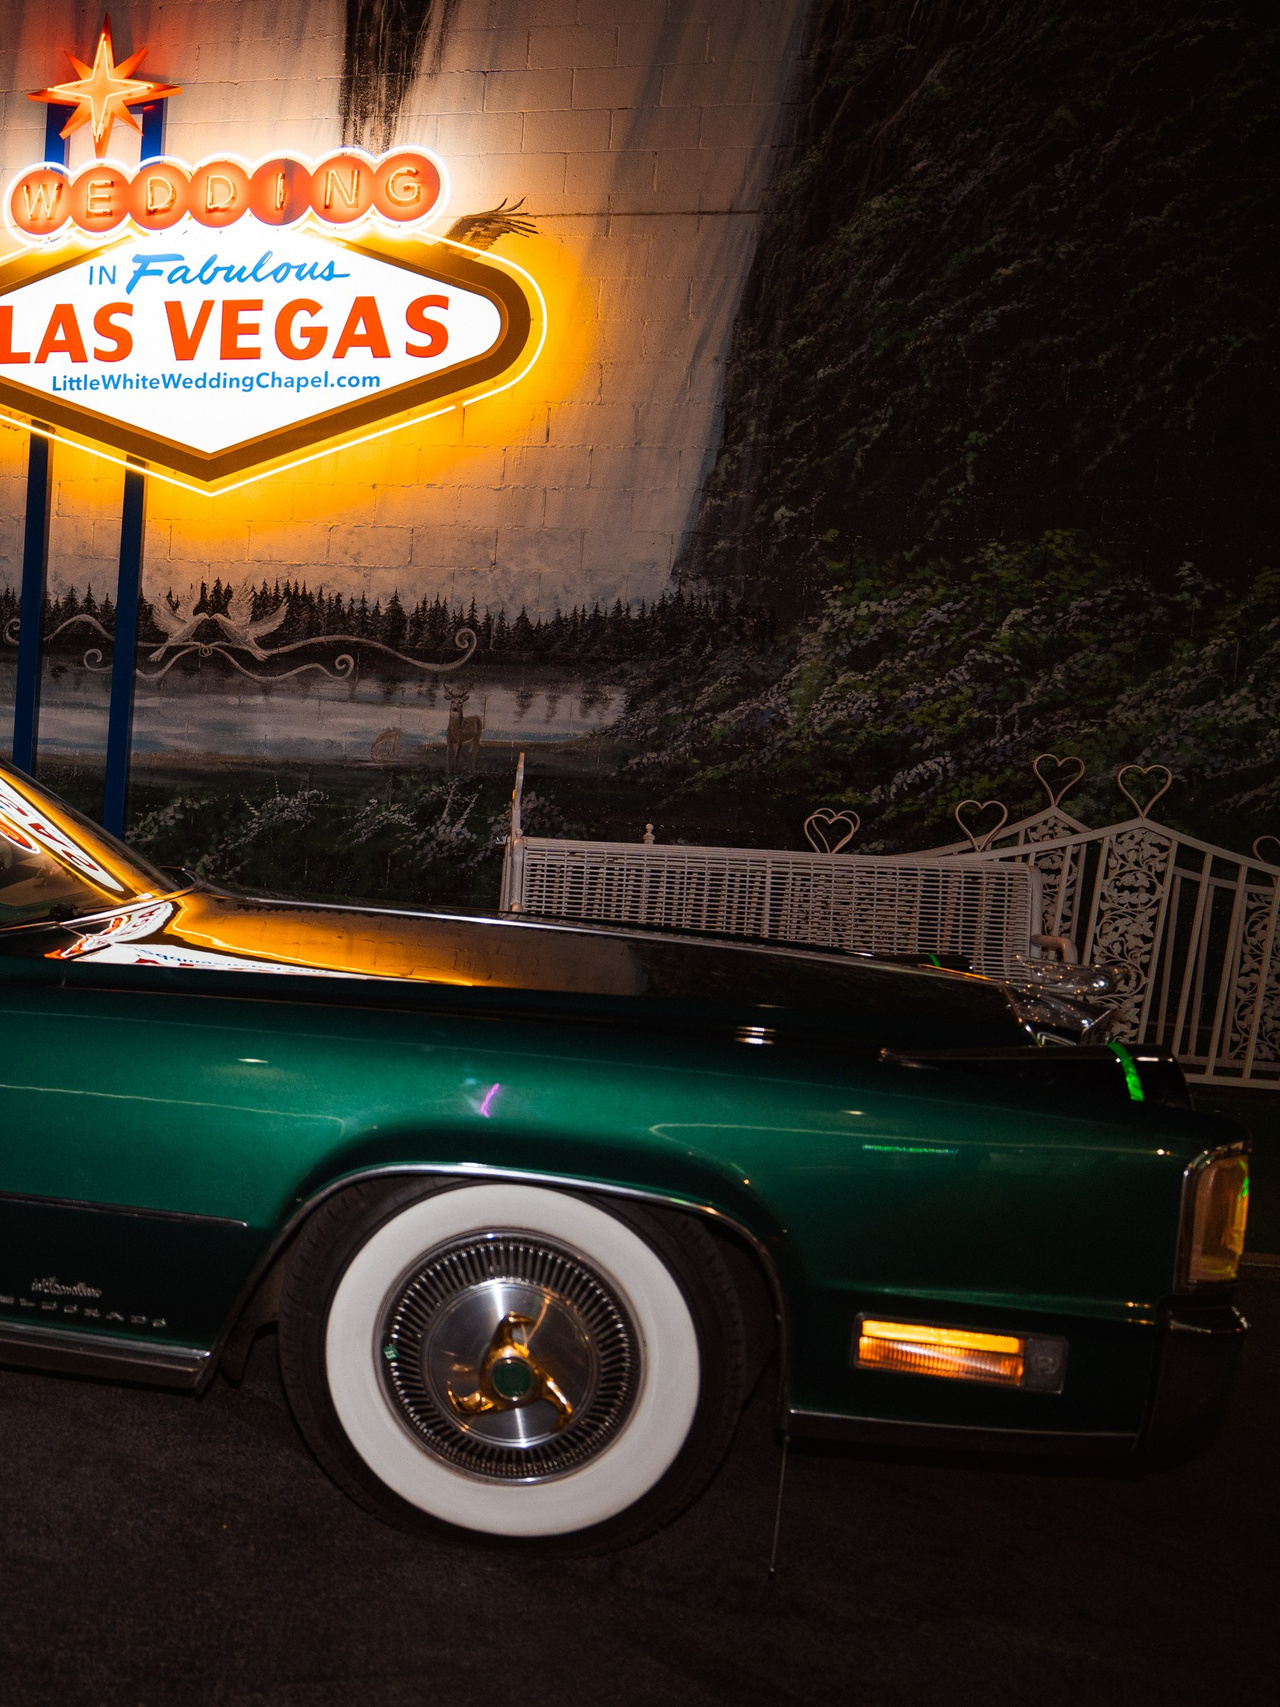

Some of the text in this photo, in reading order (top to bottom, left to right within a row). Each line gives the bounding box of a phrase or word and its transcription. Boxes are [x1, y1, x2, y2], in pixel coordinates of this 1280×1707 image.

[21, 164, 422, 221] WEDDING
[88, 249, 351, 296] IN Fabulous
[163, 294, 451, 362] VEGAS
[51, 371, 382, 394] LittleWhiteWeddingChapel.com
